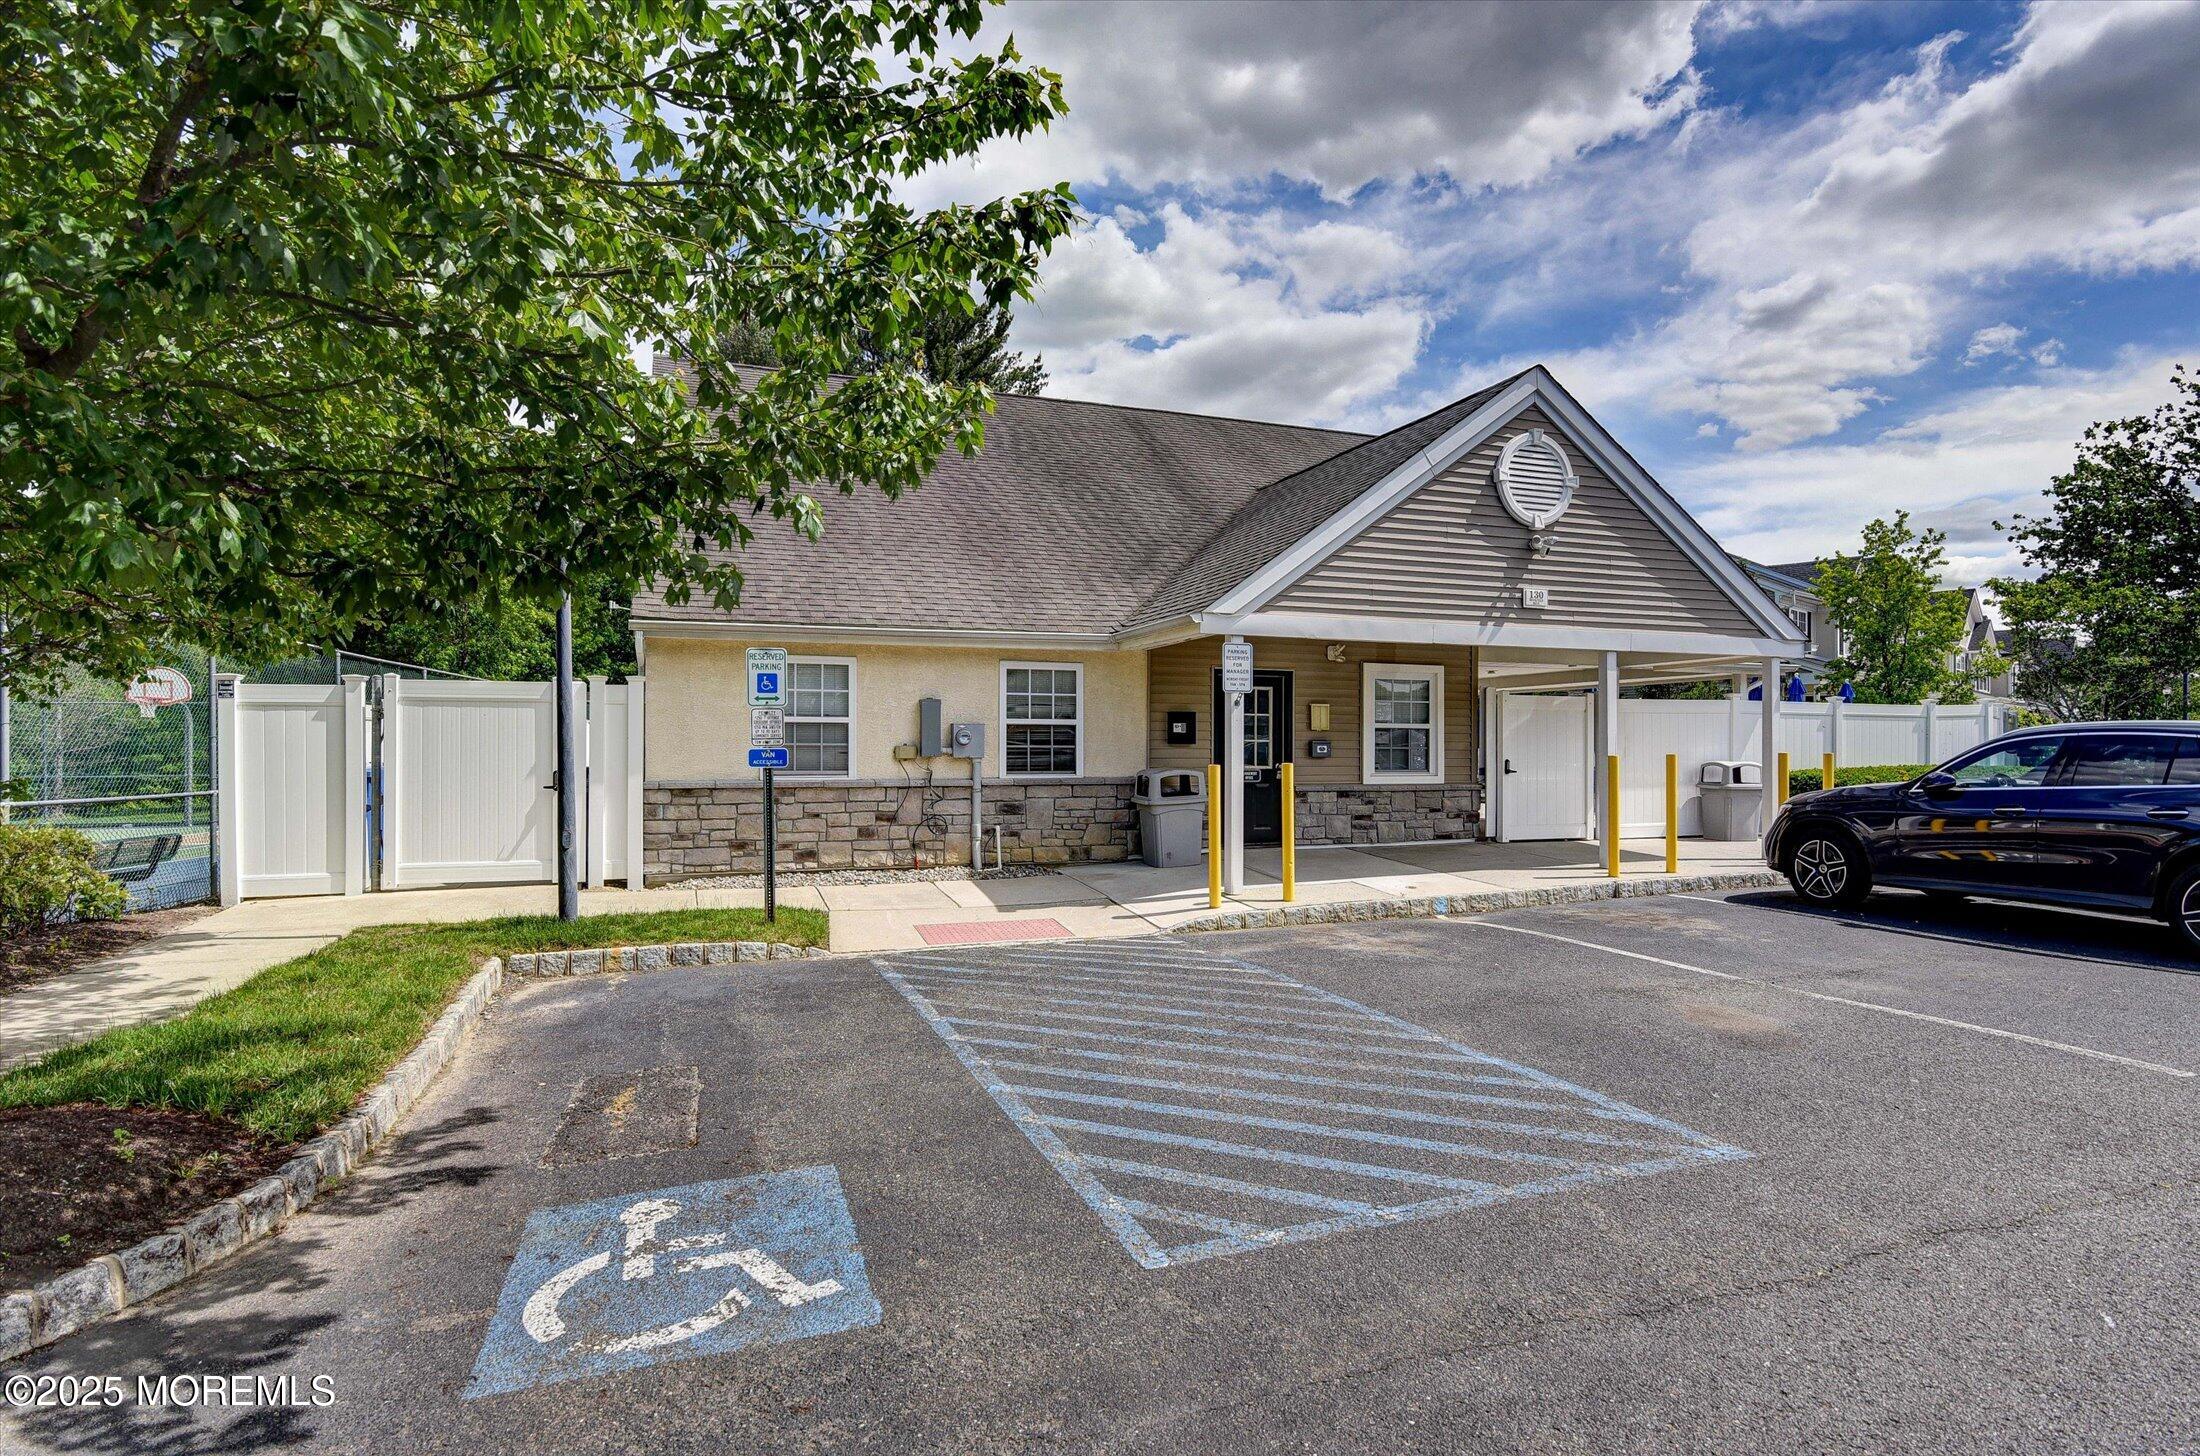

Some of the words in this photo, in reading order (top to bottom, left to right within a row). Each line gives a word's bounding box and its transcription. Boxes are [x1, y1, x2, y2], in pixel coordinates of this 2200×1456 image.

[1530, 590, 1544, 599] 130
[749, 652, 784, 661] RESERVED
[751, 662, 782, 671] PARKING
